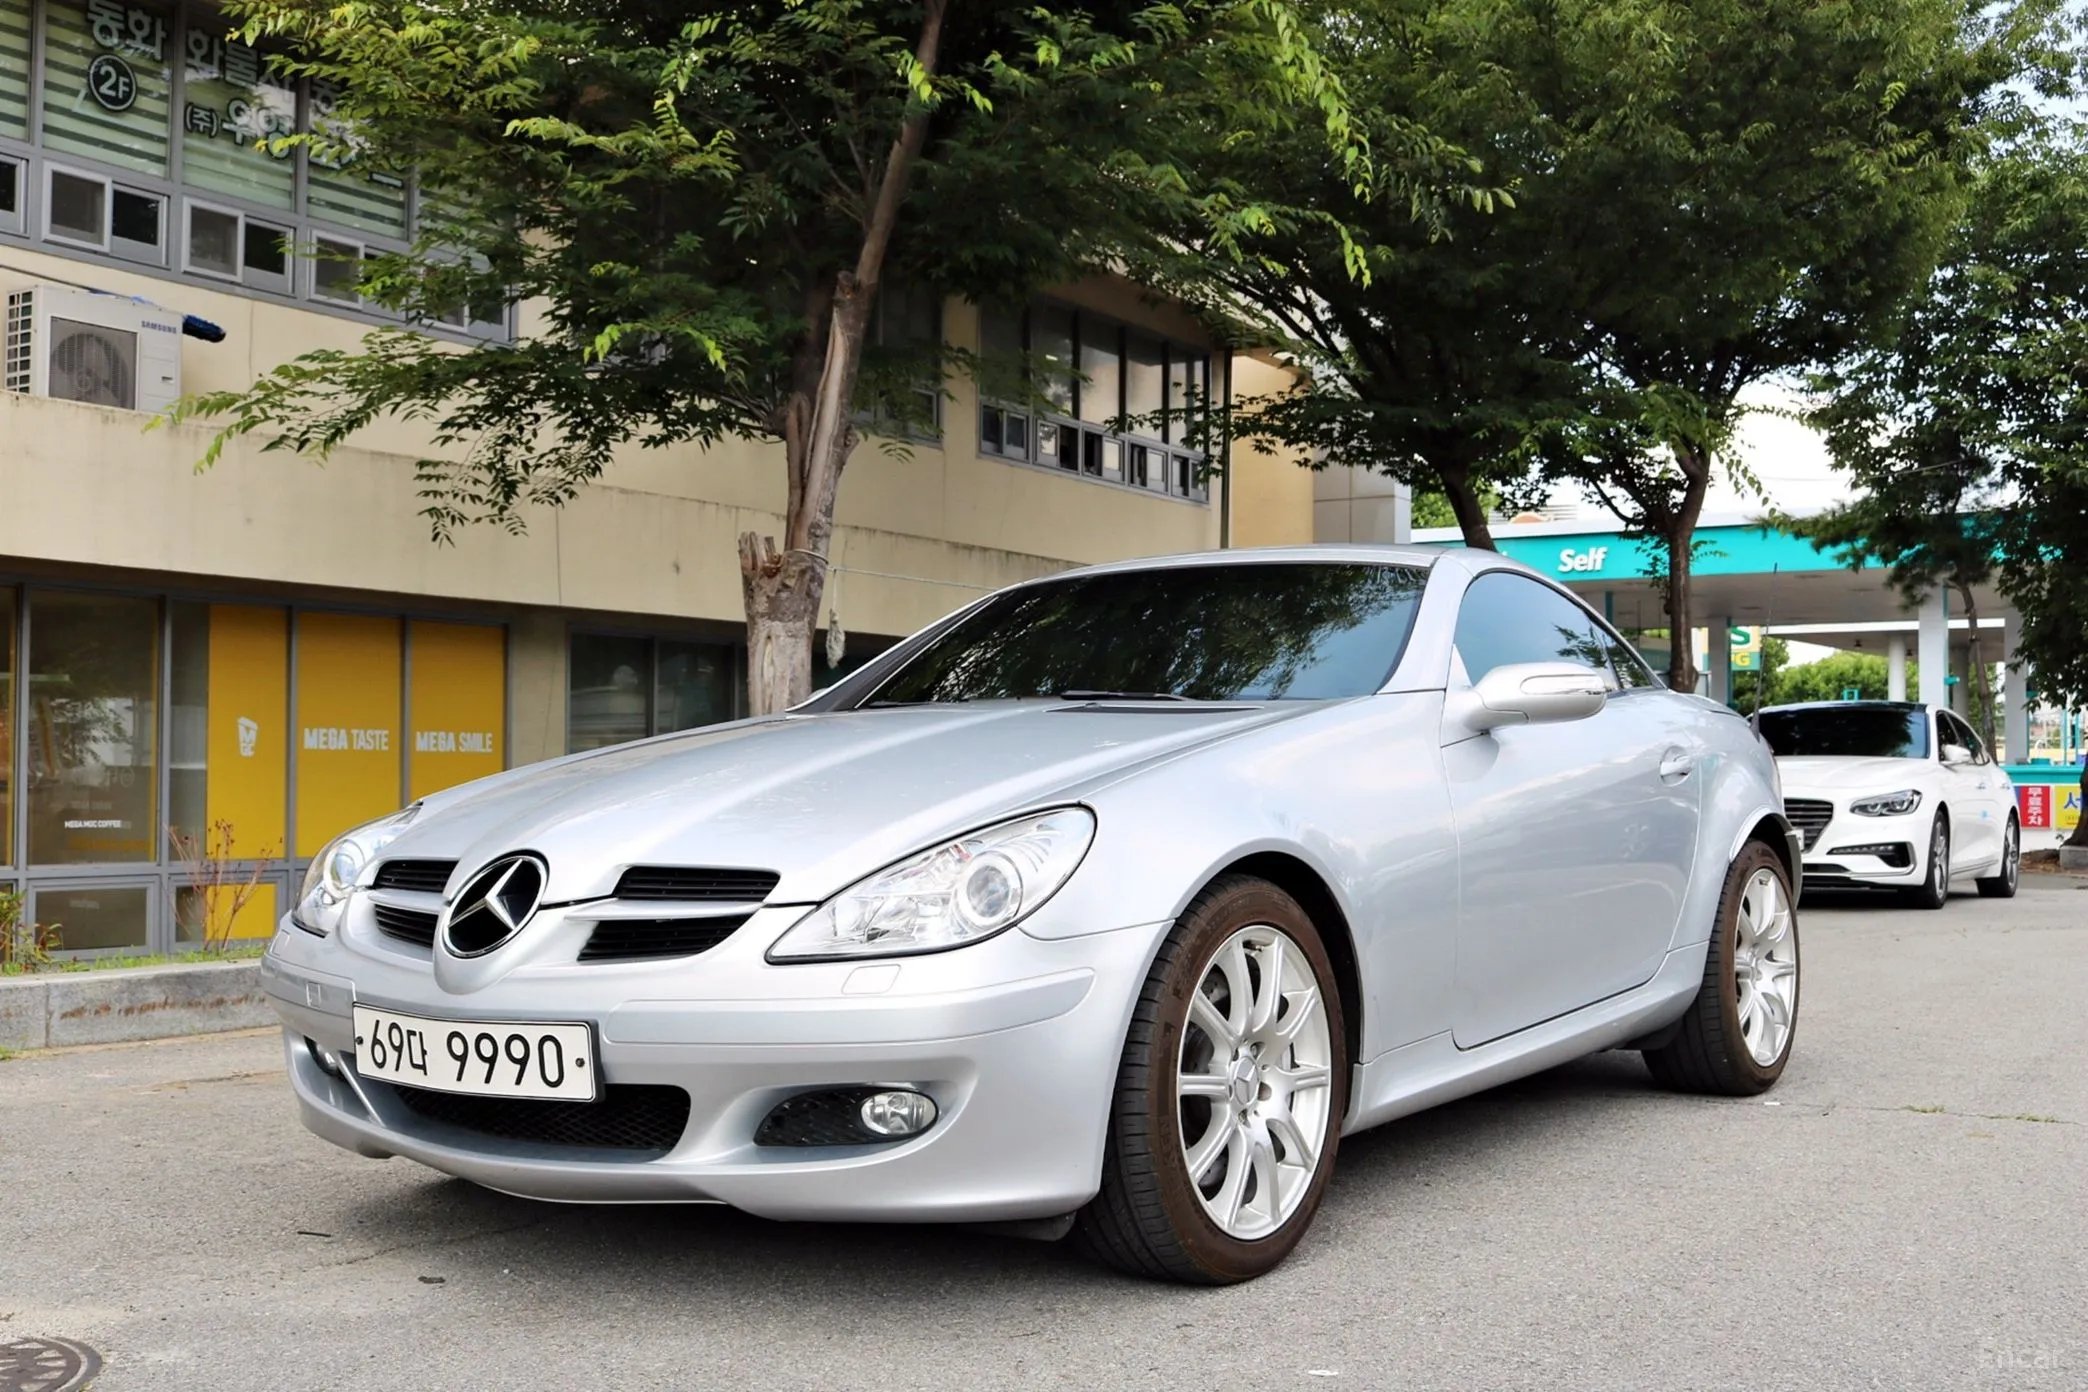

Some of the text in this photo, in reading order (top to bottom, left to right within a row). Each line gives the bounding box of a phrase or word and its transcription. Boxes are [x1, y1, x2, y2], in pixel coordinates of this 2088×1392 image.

[87, 0, 167, 61] 동화
[99, 64, 130, 99] 2F
[141, 320, 177, 334] SAMSUNG
[1557, 546, 1608, 572] Self
[304, 727, 390, 751] MEGA TASTE
[416, 731, 493, 753] MEGA SMILE
[98, 819, 121, 828] COFFEE
[371, 1019, 565, 1088] 69다 9990
